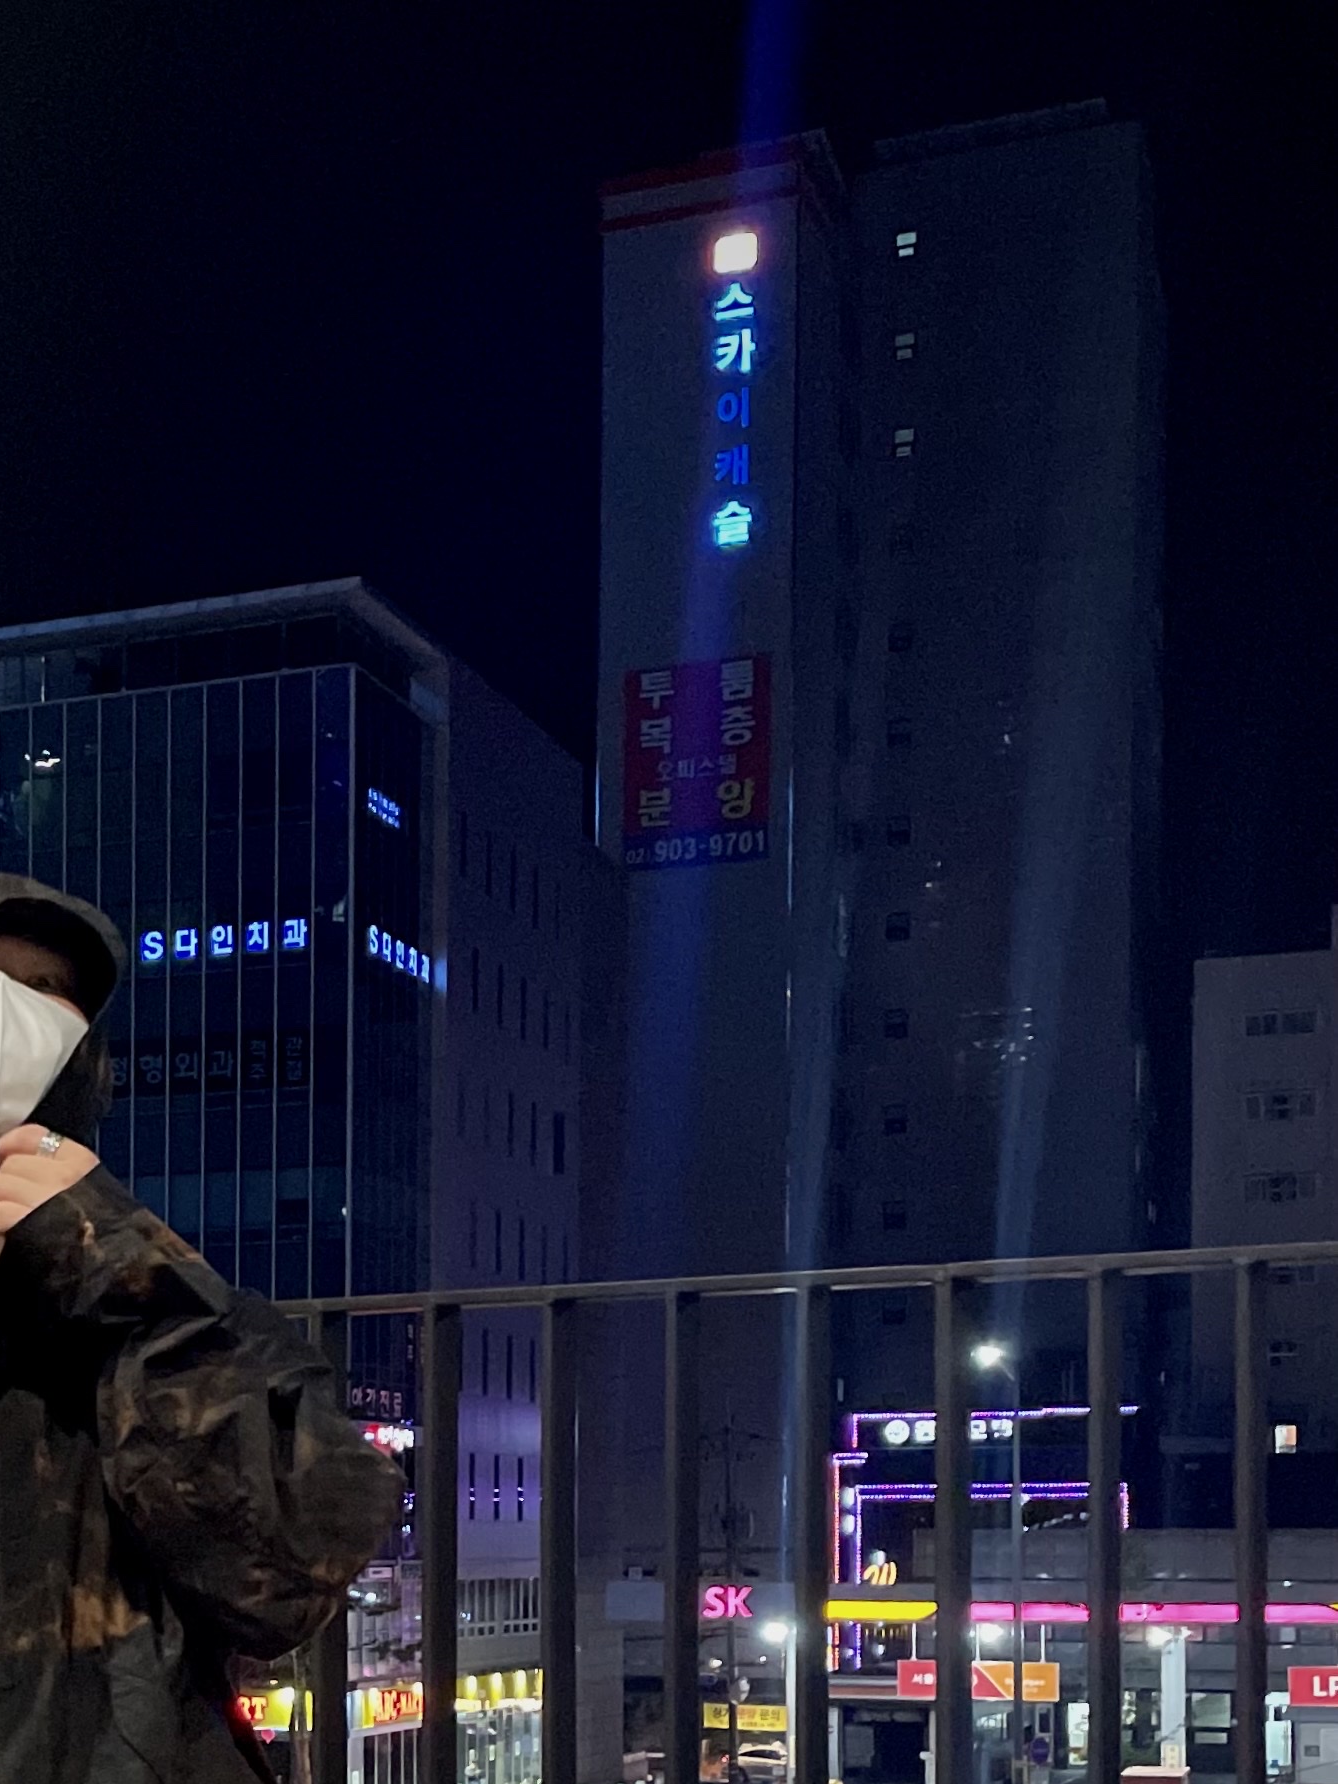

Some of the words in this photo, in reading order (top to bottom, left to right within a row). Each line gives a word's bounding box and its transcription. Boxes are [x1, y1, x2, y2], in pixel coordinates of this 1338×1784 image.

[714, 282, 756, 547] 스카이캐슬
[143, 918, 308, 960] S다인치과
[703, 1586, 753, 1618] SK
